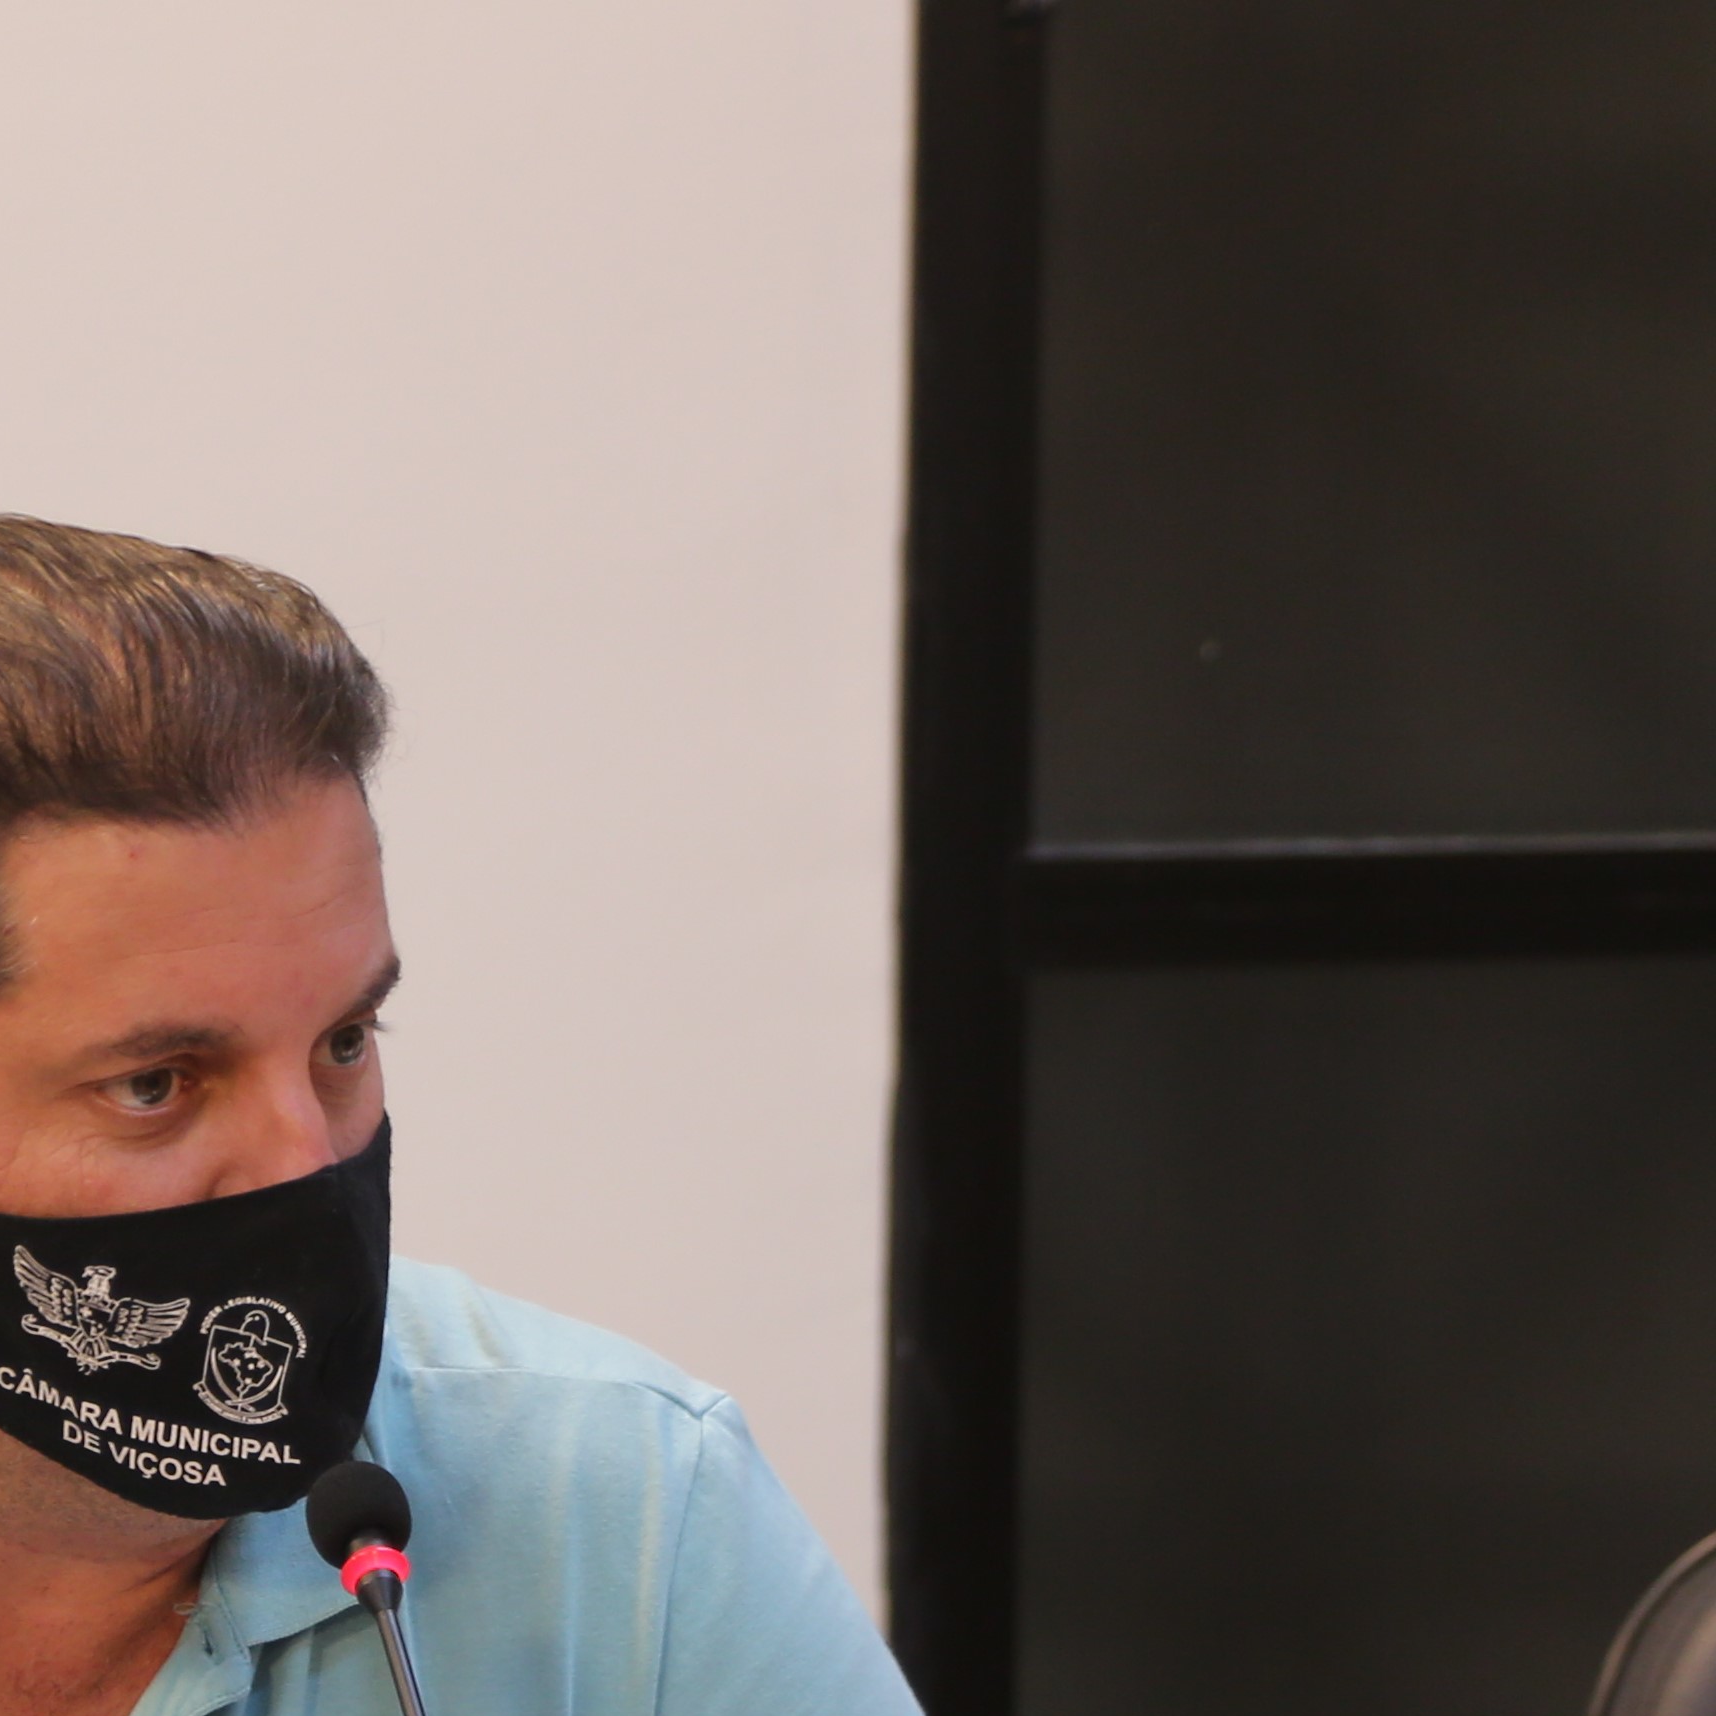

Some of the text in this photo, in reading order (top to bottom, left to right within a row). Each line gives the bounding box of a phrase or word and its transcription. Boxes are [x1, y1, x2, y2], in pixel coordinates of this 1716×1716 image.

[62, 1420, 227, 1487] DE VIÇOSA
[130, 1416, 301, 1465] MUNICIPAL
